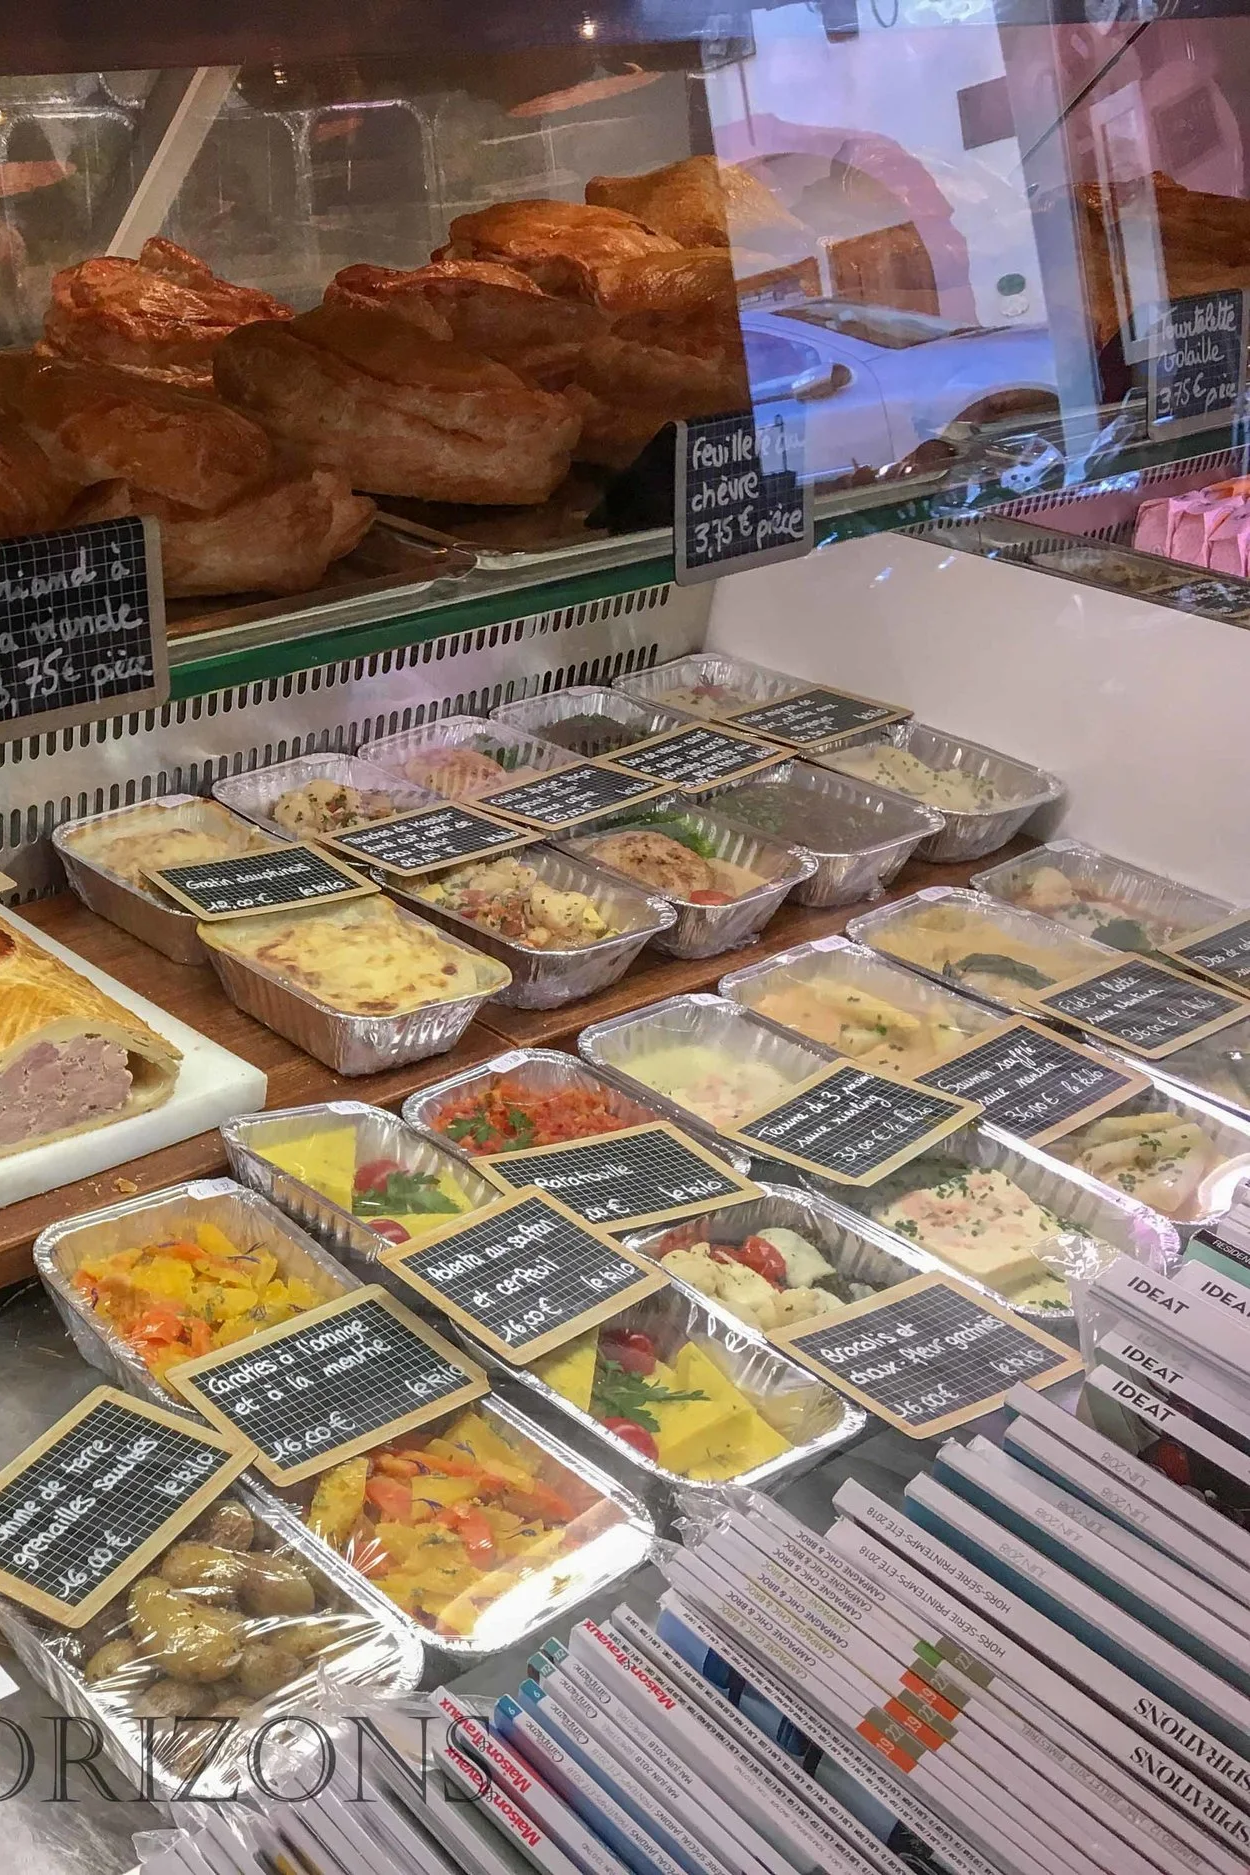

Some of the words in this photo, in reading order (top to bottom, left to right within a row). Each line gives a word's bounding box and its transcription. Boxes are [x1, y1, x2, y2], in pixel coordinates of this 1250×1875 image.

[691, 471, 759, 512] chèvre
[695, 514, 733, 558] 3,75
[756, 502, 804, 549] pièce
[31, 596, 143, 644] viande
[186, 874, 235, 891] Gratin
[1058, 995, 1097, 1015] Filet
[1100, 976, 1141, 993] lotte
[937, 1069, 996, 1096] Saumon
[995, 1040, 1037, 1071] soufflé
[757, 1113, 809, 1139] Terrine
[808, 1101, 831, 1115] de
[820, 1091, 842, 1104] 3
[796, 1125, 832, 1149] sauce
[835, 1094, 892, 1126] riesling
[871, 1128, 892, 1141] €
[882, 1121, 908, 1133] le
[894, 1105, 933, 1127] kilo
[533, 1162, 634, 1190] Ratatouille
[426, 1252, 486, 1282] Polenta
[485, 1244, 510, 1259] au
[507, 1216, 559, 1249] safran
[472, 1290, 496, 1309] et
[495, 1256, 561, 1296] cerfeuil
[500, 1310, 546, 1343] 16,00
[539, 1297, 563, 1316] €
[580, 1275, 608, 1292] le
[598, 1262, 636, 1285] kilo
[1127, 1276, 1189, 1315] IDEAT
[207, 1359, 278, 1396] Carottes
[279, 1349, 295, 1366] à
[296, 1318, 371, 1356] l'orange
[820, 1330, 898, 1364] Brocolis
[898, 1322, 918, 1338] et
[234, 1398, 260, 1415] et
[267, 1384, 285, 1401] à
[286, 1373, 315, 1391] la
[322, 1337, 393, 1378] menthe
[938, 1383, 960, 1400] €
[988, 1361, 1011, 1375] le
[1004, 1348, 1046, 1371] kilo
[1121, 1345, 1184, 1385] IDEAT
[270, 1425, 332, 1462] 16,00
[329, 1410, 357, 1432] €
[404, 1379, 432, 1399] le
[421, 1362, 466, 1394] kilo
[1112, 1380, 1176, 1423] IDEAT
[40, 1479, 67, 1500] de
[60, 1438, 114, 1475] terre
[12, 1493, 96, 1570] grenailles
[92, 1436, 159, 1492] sautées
[104, 1529, 133, 1548] €
[154, 1477, 185, 1499] le
[178, 1452, 216, 1484] kilo
[866, 1506, 888, 1524] 2018
[796, 1531, 817, 1548] BROC
[818, 1546, 825, 1554] &
[823, 1552, 844, 1569] CHIC
[859, 1546, 881, 1564] 2018
[886, 1520, 957, 1574] PRINTEMPS-ÉTÉ
[757, 1573, 781, 1592] BROC
[779, 1590, 787, 1598] &
[842, 1566, 886, 1602] CAMPAGNE
[881, 1561, 951, 1617] PRINTEMPS-ÉTÉ
[955, 1568, 1012, 1614] HORS-SÉRIE
[785, 1595, 805, 1614] CHIC
[804, 1612, 849, 1649] CAMPAGNE
[949, 1612, 1006, 1658] HORS-SÉRIE
